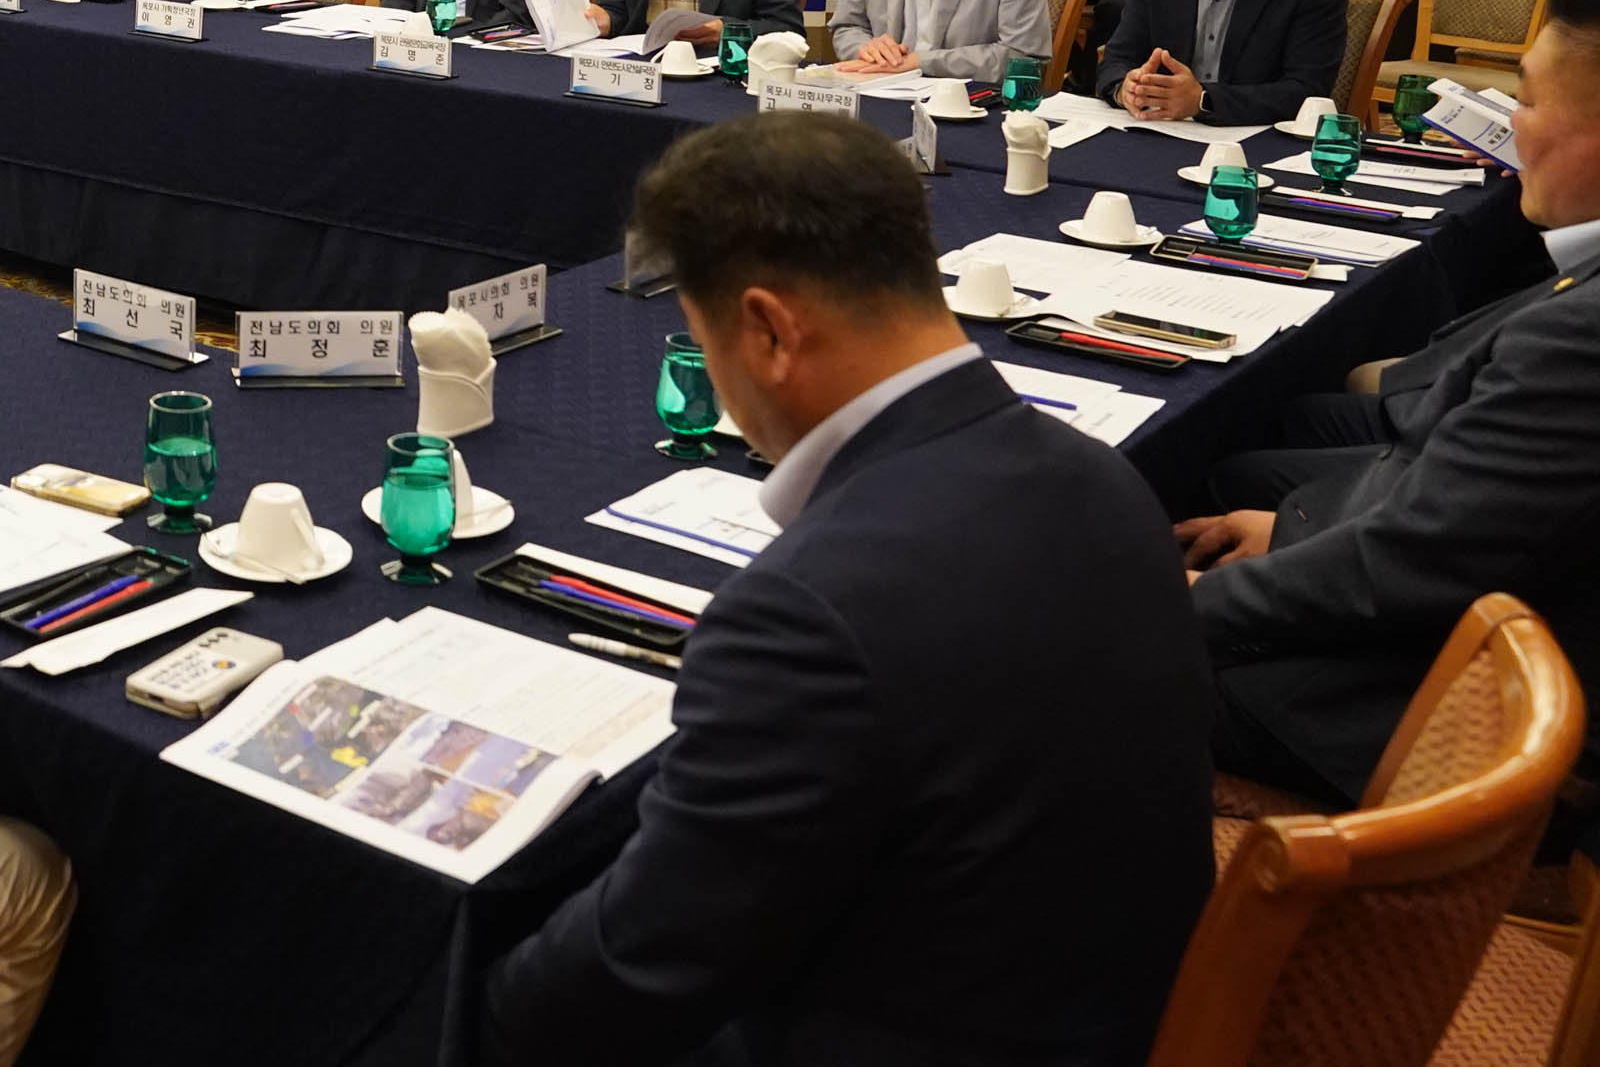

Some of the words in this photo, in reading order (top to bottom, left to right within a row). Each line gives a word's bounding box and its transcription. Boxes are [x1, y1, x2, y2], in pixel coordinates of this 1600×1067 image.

[766, 85, 792, 98] 목포시
[797, 90, 853, 107] 의회사무국장
[83, 279, 147, 309] 전남도의회
[161, 299, 185, 318] 의원
[250, 319, 340, 335] 전남도의회
[360, 319, 393, 335] 의원
